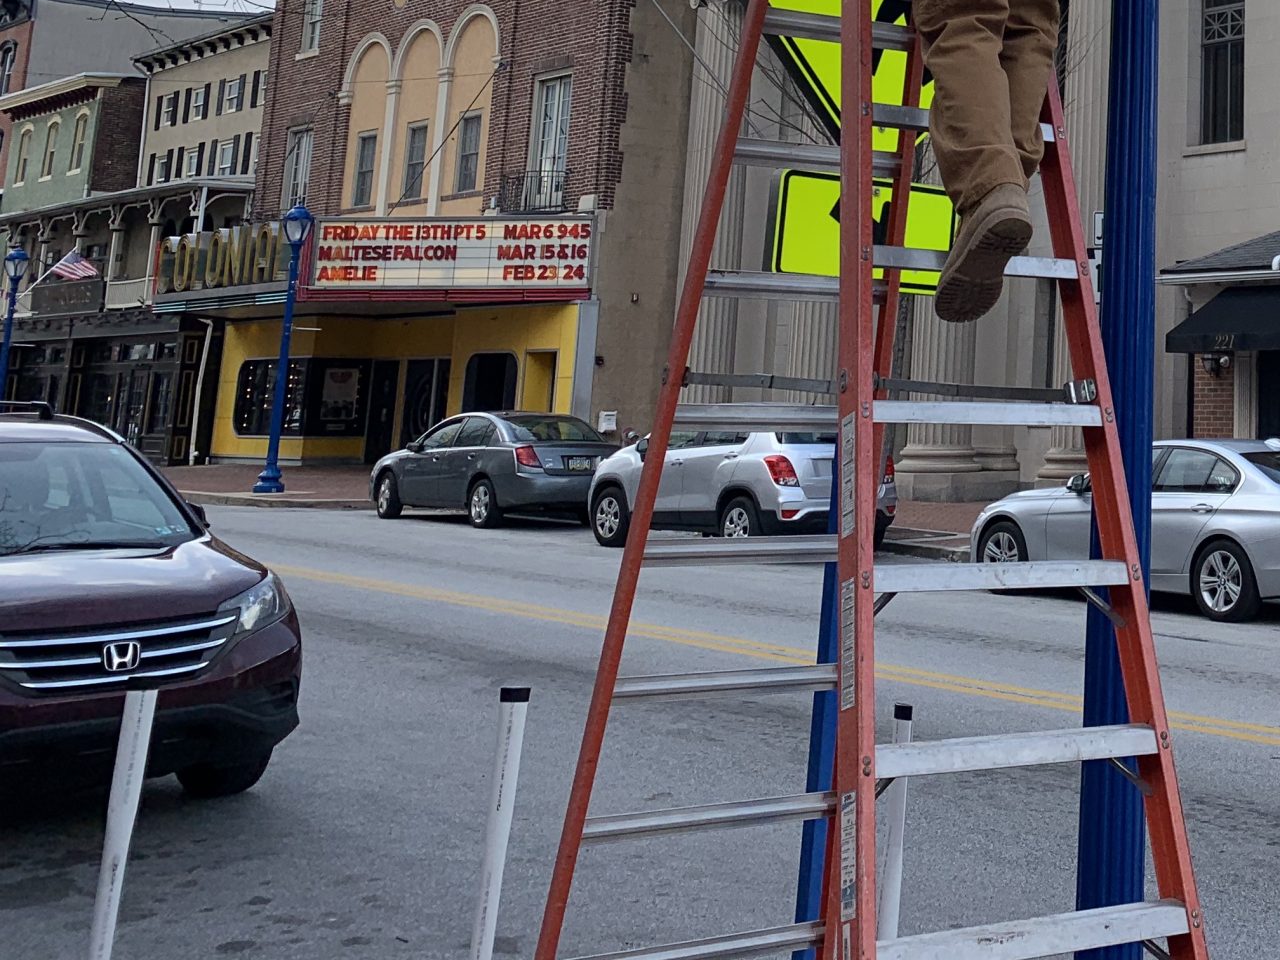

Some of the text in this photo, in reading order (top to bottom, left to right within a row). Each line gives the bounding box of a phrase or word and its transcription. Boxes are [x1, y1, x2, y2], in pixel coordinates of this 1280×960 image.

[322, 223, 592, 240] FRIDAY THE 13TH PT 5 MAR 6 945
[157, 220, 290, 294] COLONIAL
[318, 245, 392, 261] MALTESE
[393, 245, 457, 261] FALCON
[497, 244, 536, 260] MAR
[317, 264, 585, 281] AMELIE FEB 23 24
[1214, 334, 1235, 349] 221
